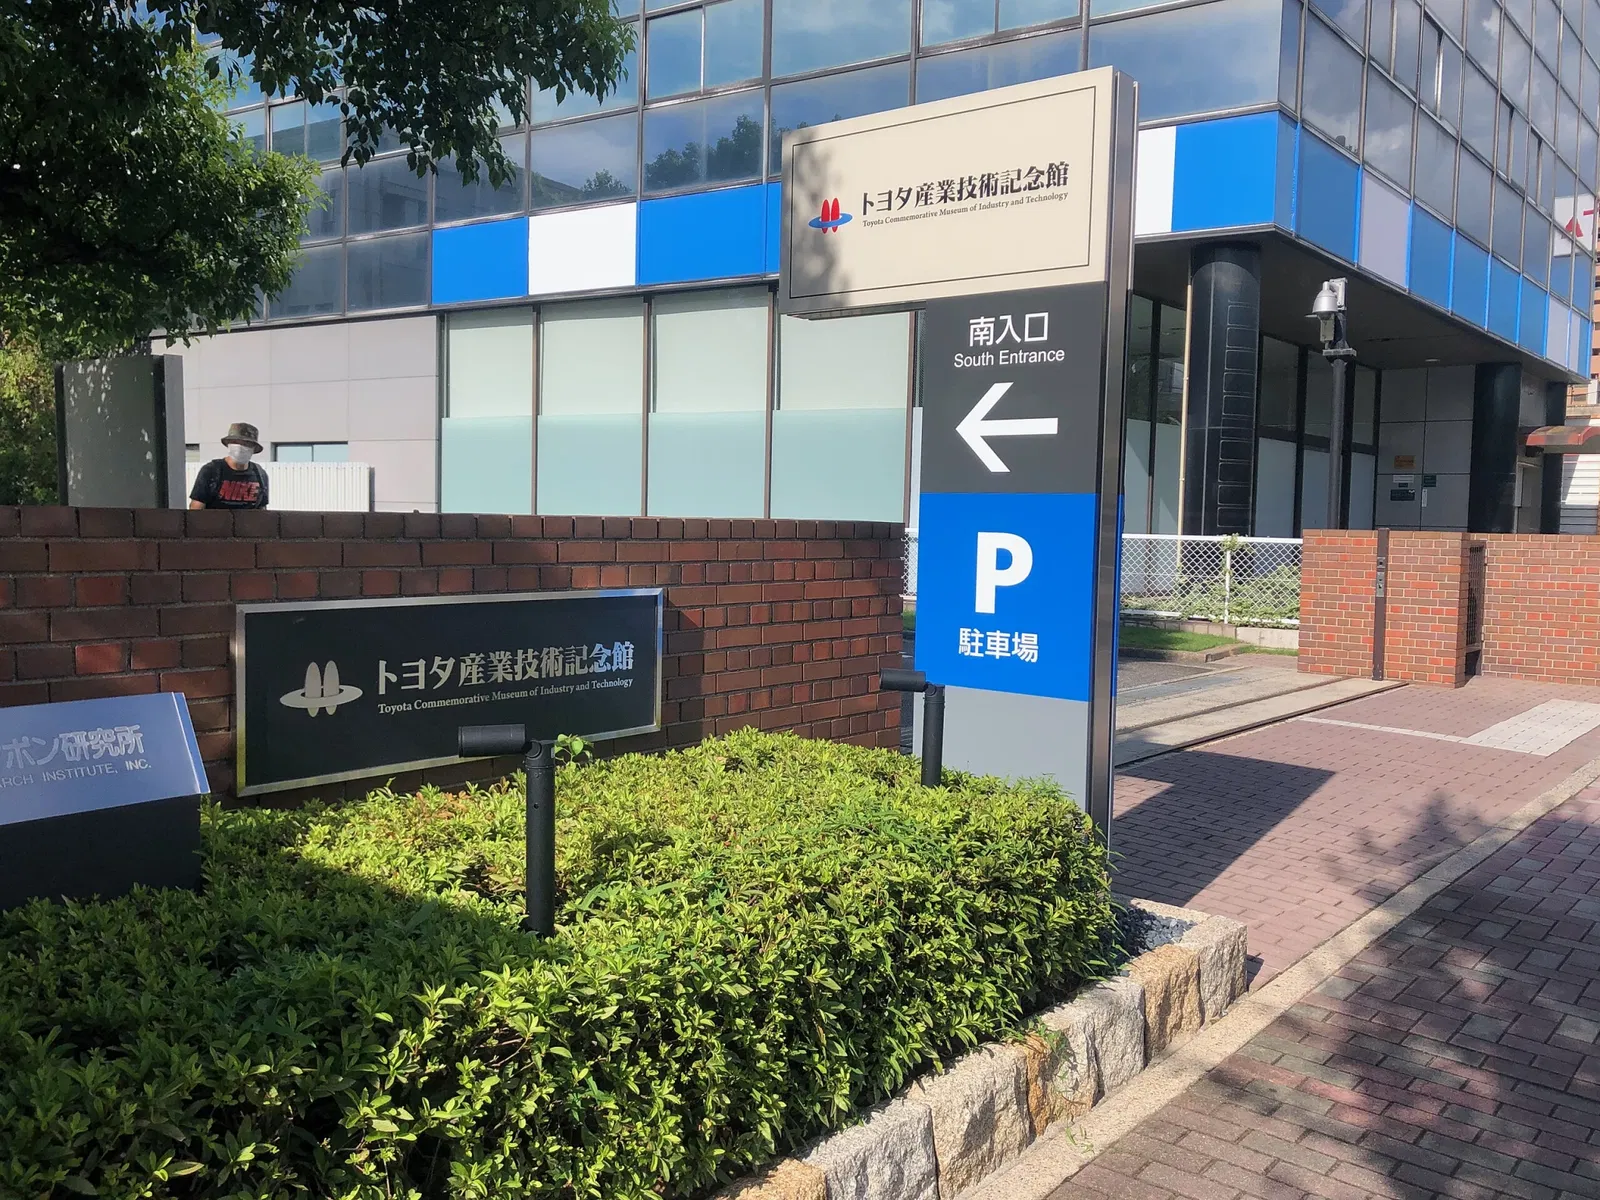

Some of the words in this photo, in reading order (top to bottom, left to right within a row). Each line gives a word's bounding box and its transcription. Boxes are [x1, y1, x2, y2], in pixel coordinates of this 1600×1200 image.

[862, 160, 1070, 216] トヨタ産業技術記念館
[862, 219, 884, 228] Toyota
[885, 209, 938, 224] Commemorative
[939, 206, 968, 216] Museum
[969, 203, 978, 212] of
[978, 200, 1009, 211] Industry
[1010, 197, 1024, 206] and
[1025, 191, 1069, 204] Technology
[969, 312, 1049, 347] 南入口
[954, 351, 994, 368] South
[999, 349, 1065, 365] Entrance
[219, 480, 260, 501] NIKE
[975, 532, 1033, 614] P
[958, 627, 1039, 663] 駐車場
[379, 641, 635, 695] トヨタ産業技術記念館
[378, 702, 412, 715] Toyota
[414, 693, 490, 710] Commemorative
[492, 689, 528, 701] Museum
[529, 686, 540, 697] of
[540, 682, 574, 695] Industry
[575, 681, 590, 691] and
[592, 677, 634, 689] Technology
[0, 774, 34, 788] RCH
[42, 763, 118, 782] INSTITUTE,
[125, 758, 152, 771] INC.
